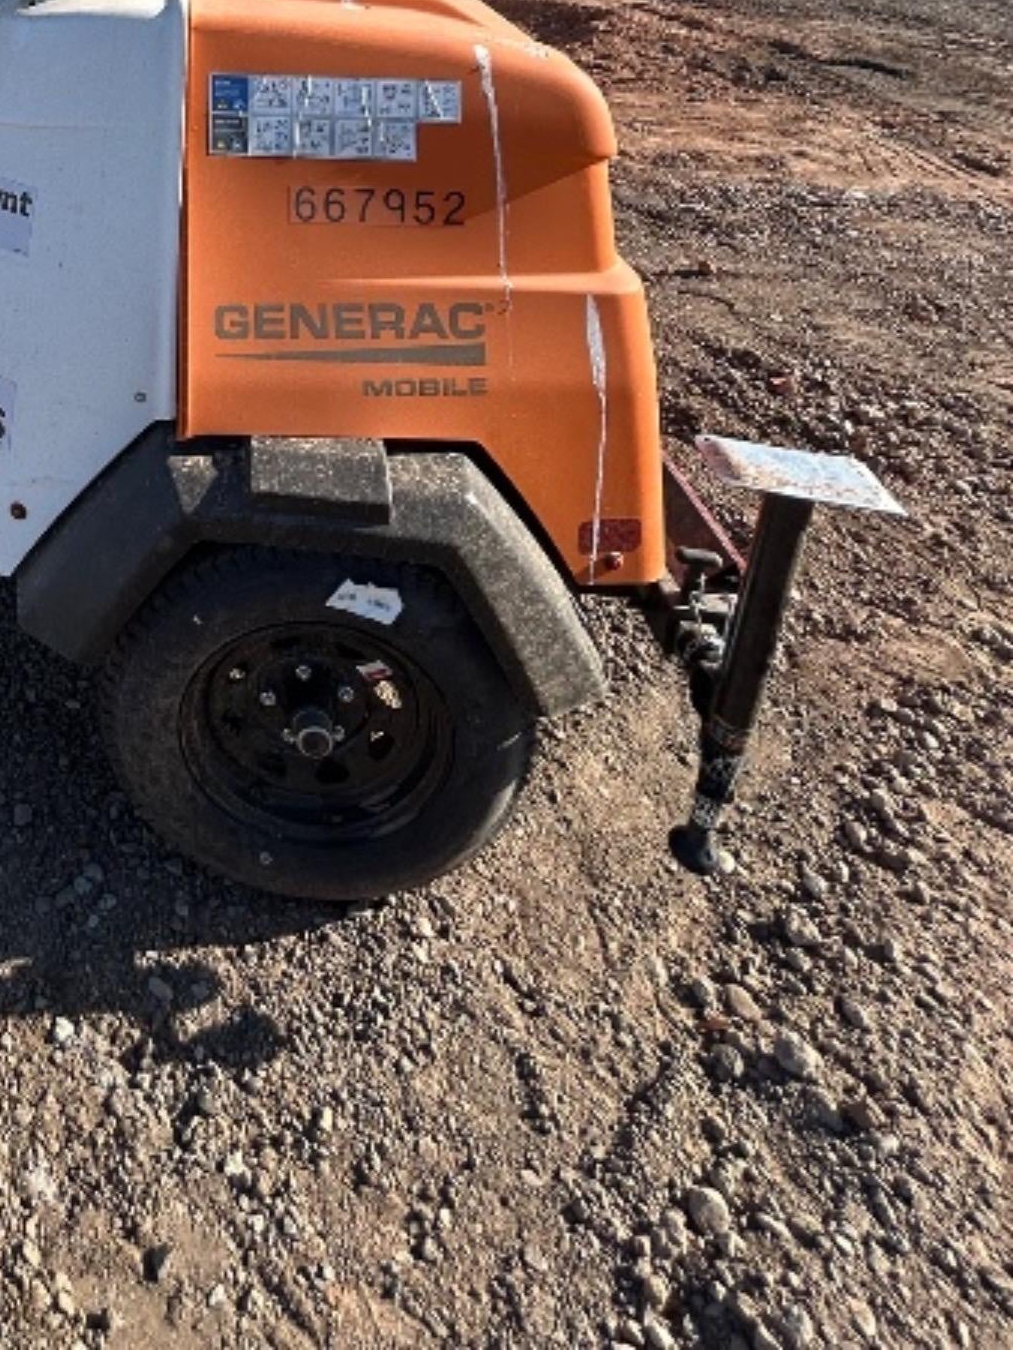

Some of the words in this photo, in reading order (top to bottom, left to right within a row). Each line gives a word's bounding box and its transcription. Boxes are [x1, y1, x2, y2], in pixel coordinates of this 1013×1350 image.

[294, 187, 467, 227] 667952
[214, 302, 486, 340] GENERAC
[362, 377, 489, 398] MOBILE
